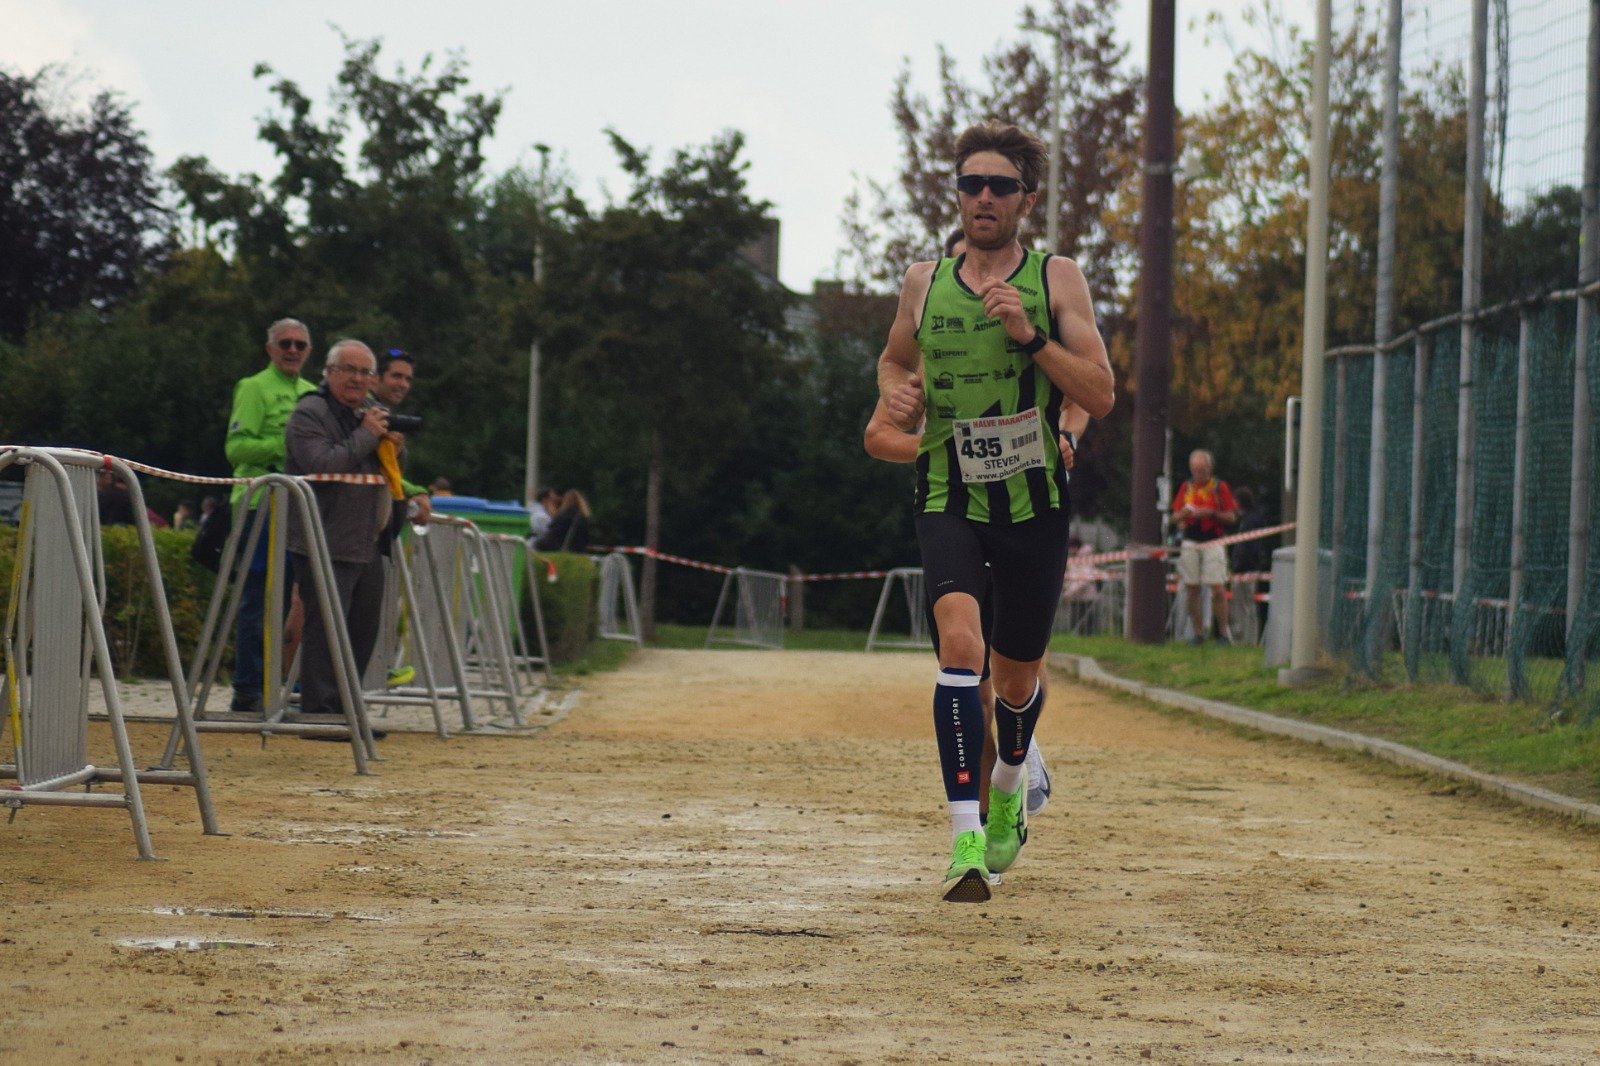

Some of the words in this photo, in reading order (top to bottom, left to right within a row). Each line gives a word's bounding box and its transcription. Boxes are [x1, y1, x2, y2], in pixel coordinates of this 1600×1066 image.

[972, 419, 997, 429] HALVE
[998, 410, 1037, 427] MARATHON
[961, 437, 1003, 459] 435
[976, 458, 1041, 480] www.plusprint.be
[984, 454, 1020, 470] STEVEN
